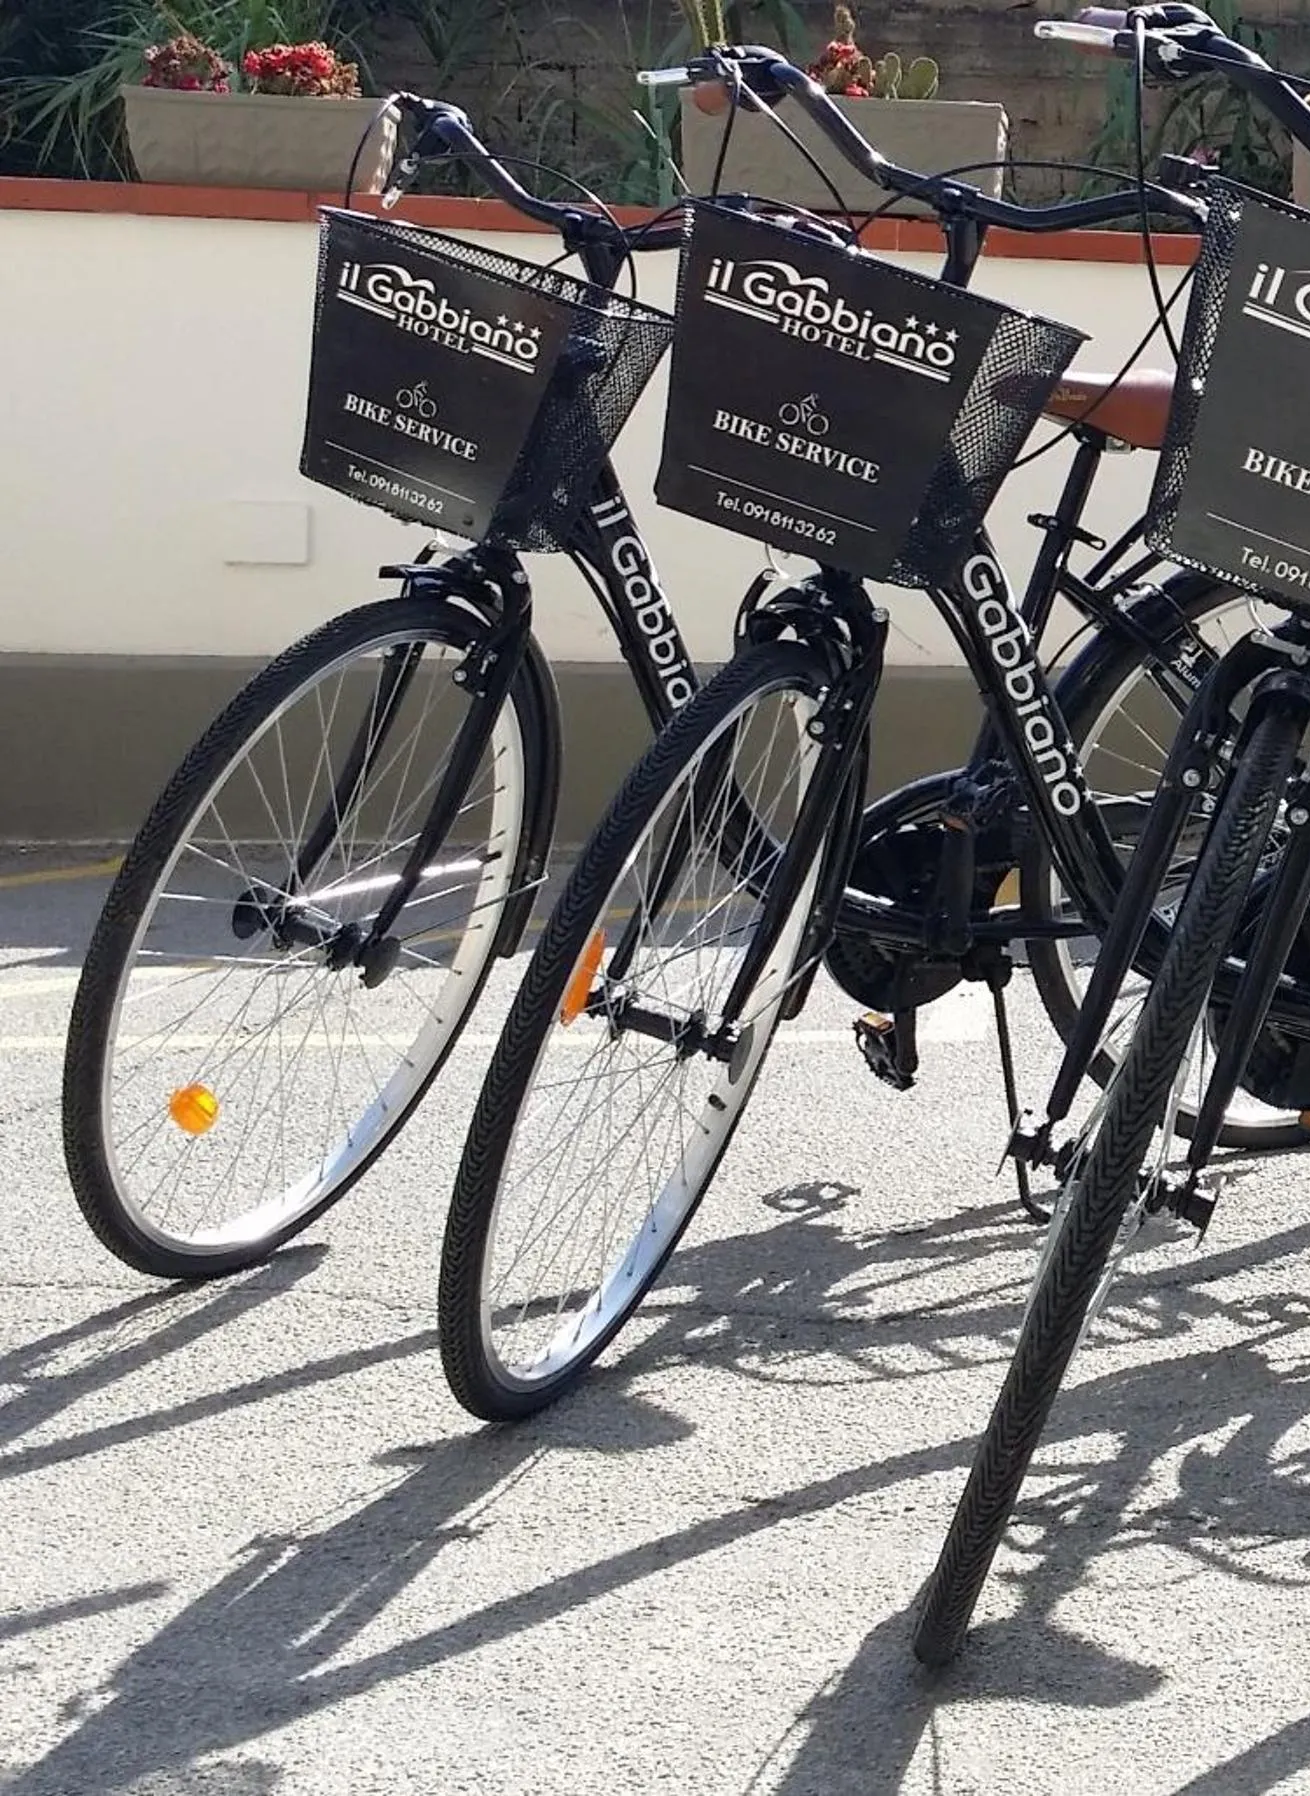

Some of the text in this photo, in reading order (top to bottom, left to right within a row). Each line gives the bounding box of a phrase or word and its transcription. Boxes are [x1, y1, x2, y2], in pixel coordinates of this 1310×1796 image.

[339, 262, 540, 361] il Gabbiano
[707, 259, 956, 368] il Gabbiano
[1248, 263, 1285, 306] il
[397, 316, 471, 355] HOTEL
[781, 318, 871, 362] HOTEL
[344, 393, 479, 463] BIKE SERVICE
[713, 410, 880, 484] BIKE SERVICE
[611, 535, 696, 710] Gabbia
[962, 554, 1080, 816] Gabbiano
